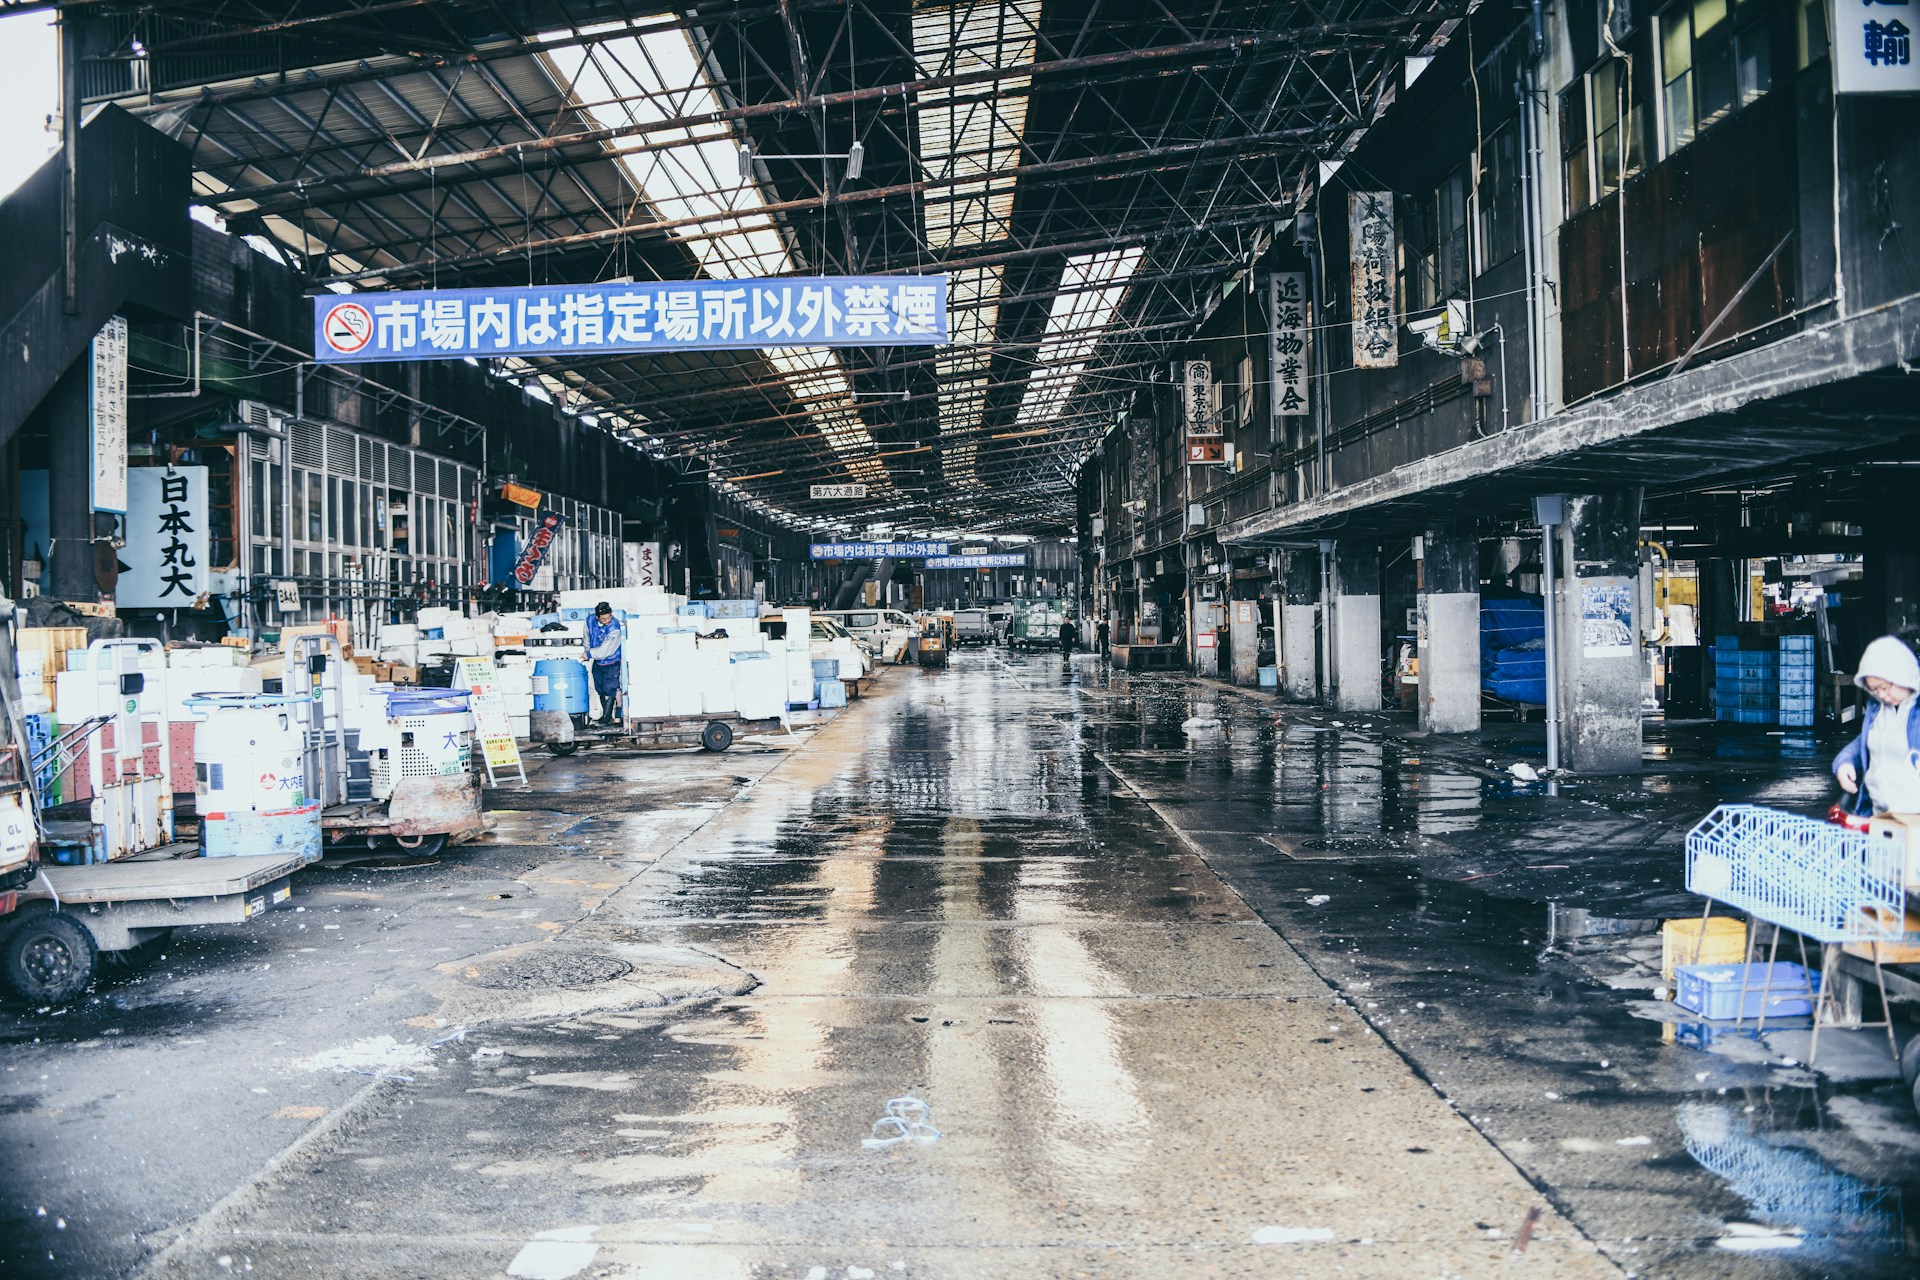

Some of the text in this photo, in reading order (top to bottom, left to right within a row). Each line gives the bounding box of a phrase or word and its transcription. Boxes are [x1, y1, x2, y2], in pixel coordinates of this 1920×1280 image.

[1863, 0, 1910, 66] 輸
[375, 284, 938, 352] 市場内は指定場所以外禁煙
[1276, 276, 1306, 411] 近海物業会
[812, 486, 863, 497] 第六大通路
[514, 527, 553, 583] まぐろ
[642, 548, 653, 586] まぐろ
[823, 543, 948, 558] 市場内は指定場所以外禁煙
[934, 555, 1025, 568] 市場内は指定場所以外禁煙
